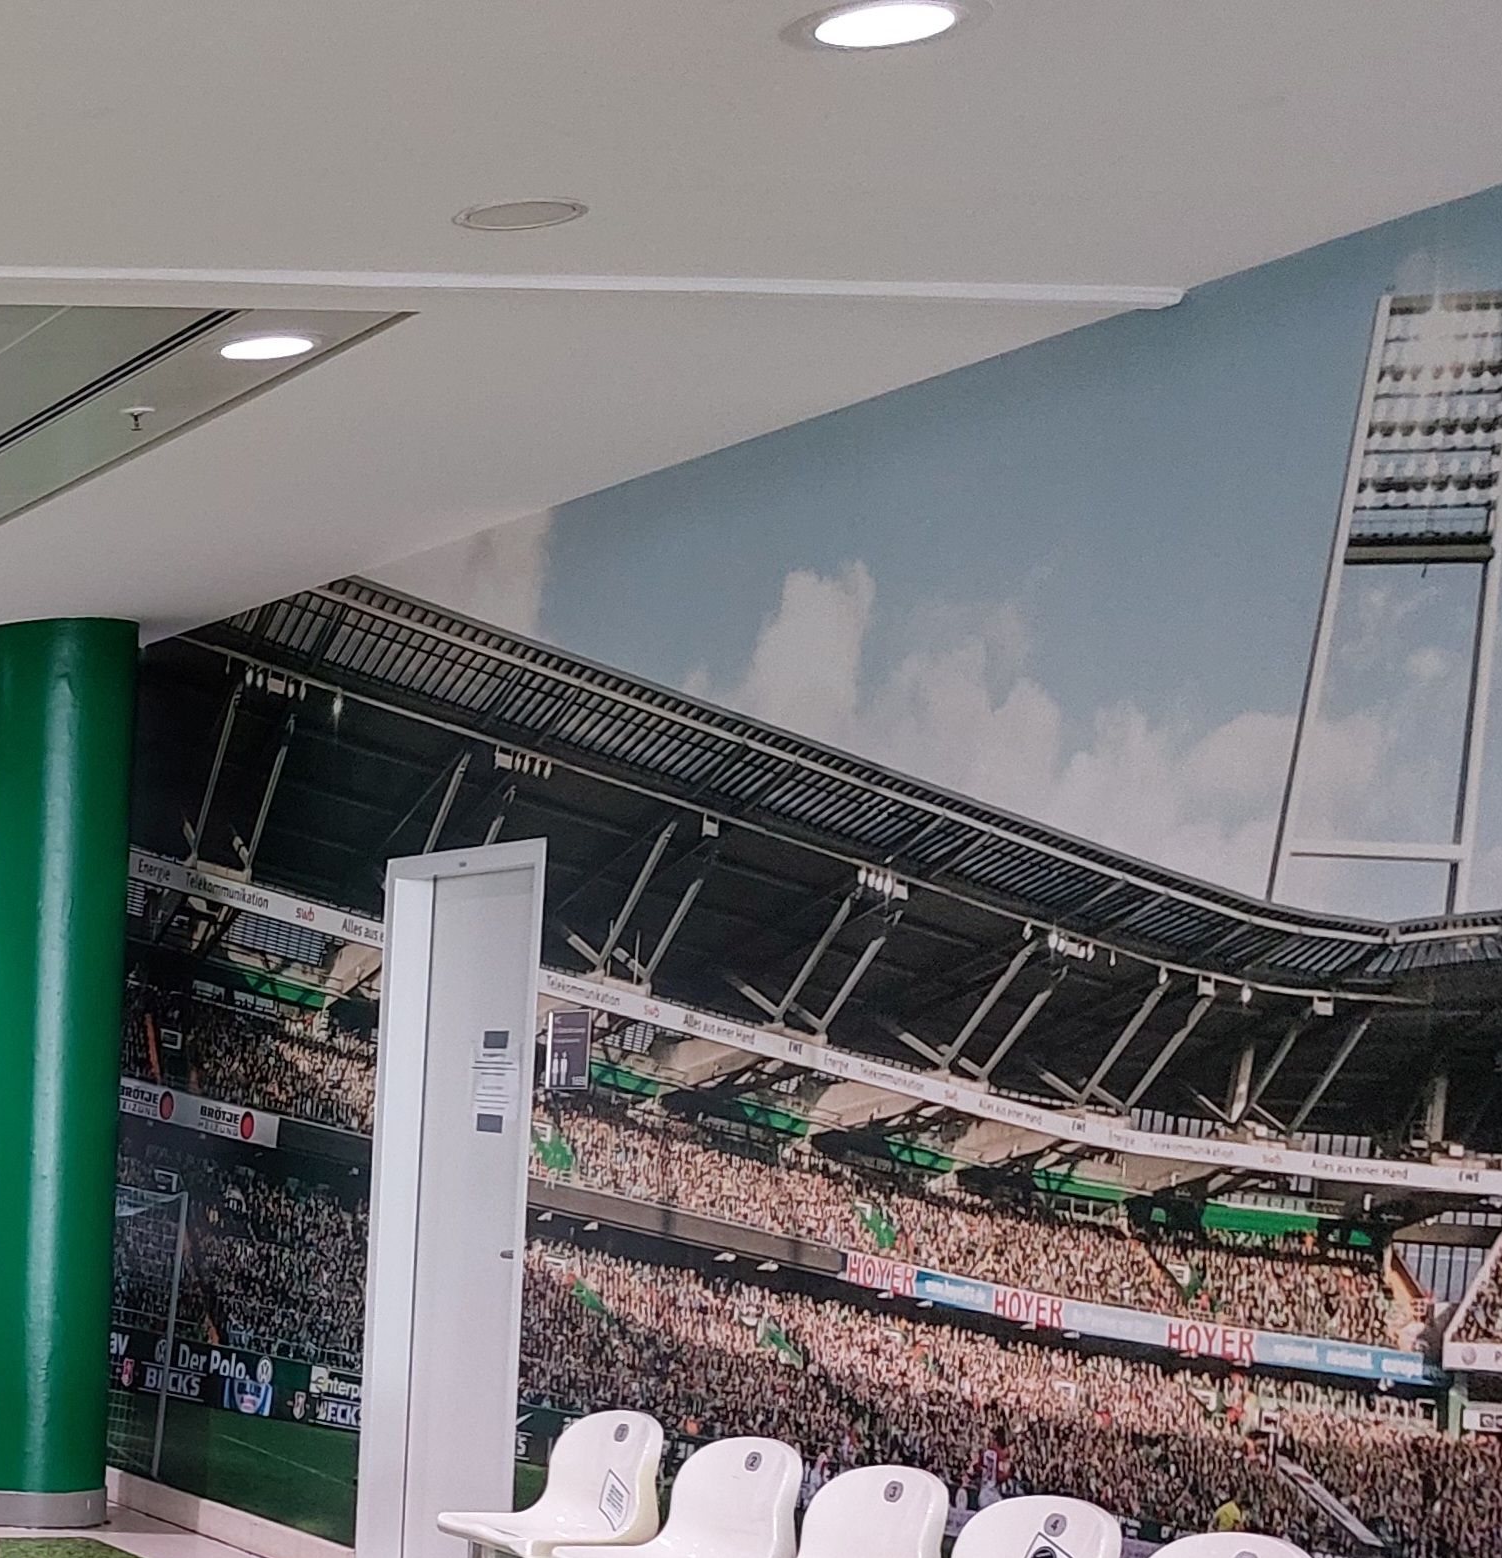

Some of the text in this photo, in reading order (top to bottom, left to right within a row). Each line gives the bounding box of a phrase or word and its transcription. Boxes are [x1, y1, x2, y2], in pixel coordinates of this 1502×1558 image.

[295, 905, 315, 923] swb
[341, 917, 363, 938] Alles
[200, 1105, 240, 1125] BRÖTJE
[847, 1253, 916, 1295] HOYER
[994, 1288, 1064, 1329] HOYER
[1167, 1323, 1256, 1363] HOYER
[177, 1343, 207, 1373] Der
[209, 1350, 250, 1381] Polo.
